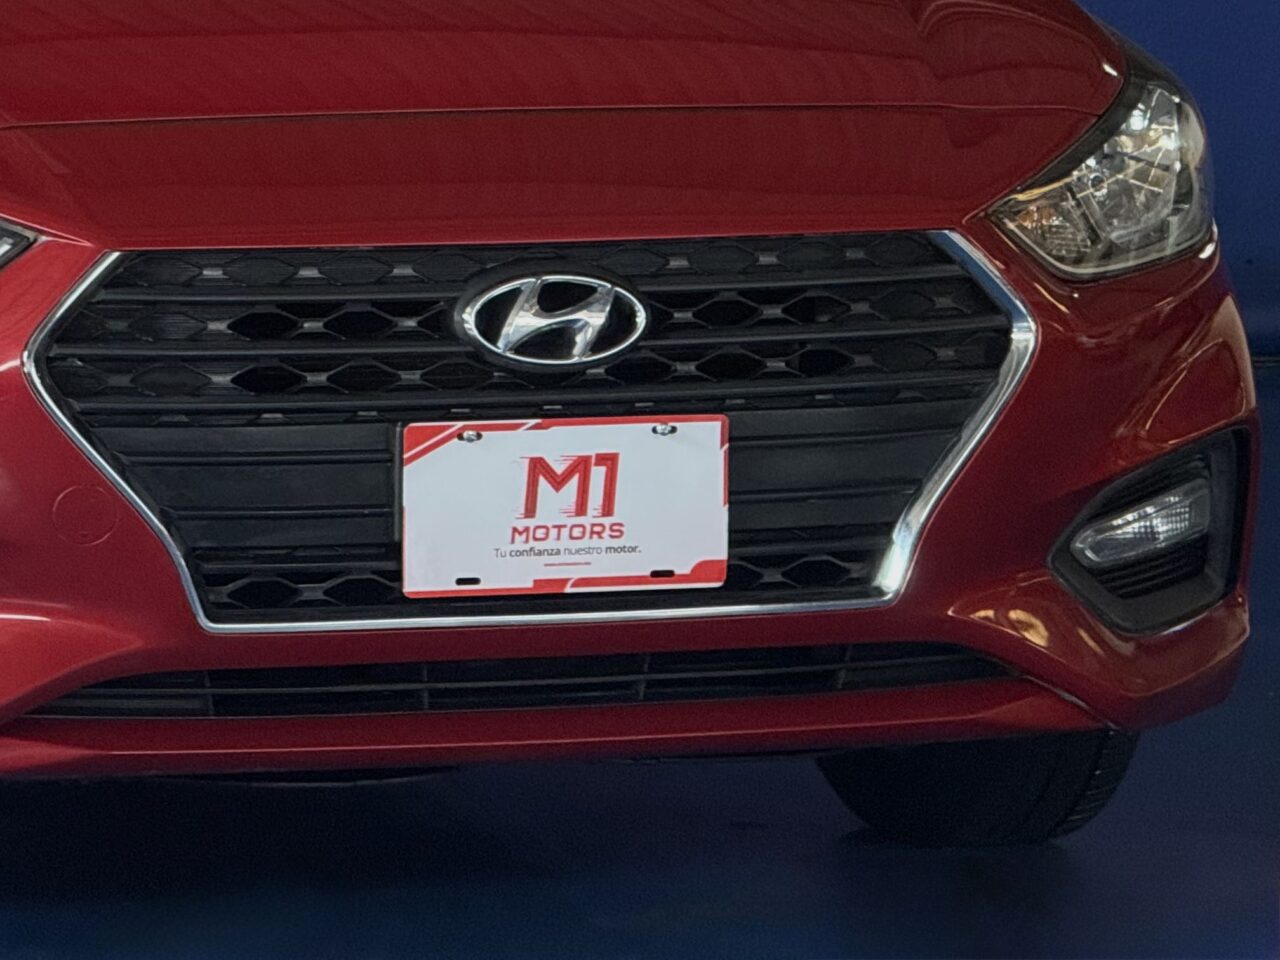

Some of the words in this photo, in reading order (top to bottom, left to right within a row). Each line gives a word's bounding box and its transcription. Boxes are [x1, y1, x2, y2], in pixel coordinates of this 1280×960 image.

[516, 452, 620, 519] M1
[510, 522, 625, 544] MOTORS
[493, 548, 507, 558] Tu
[509, 546, 561, 558] confianza
[563, 545, 602, 556] nuestro
